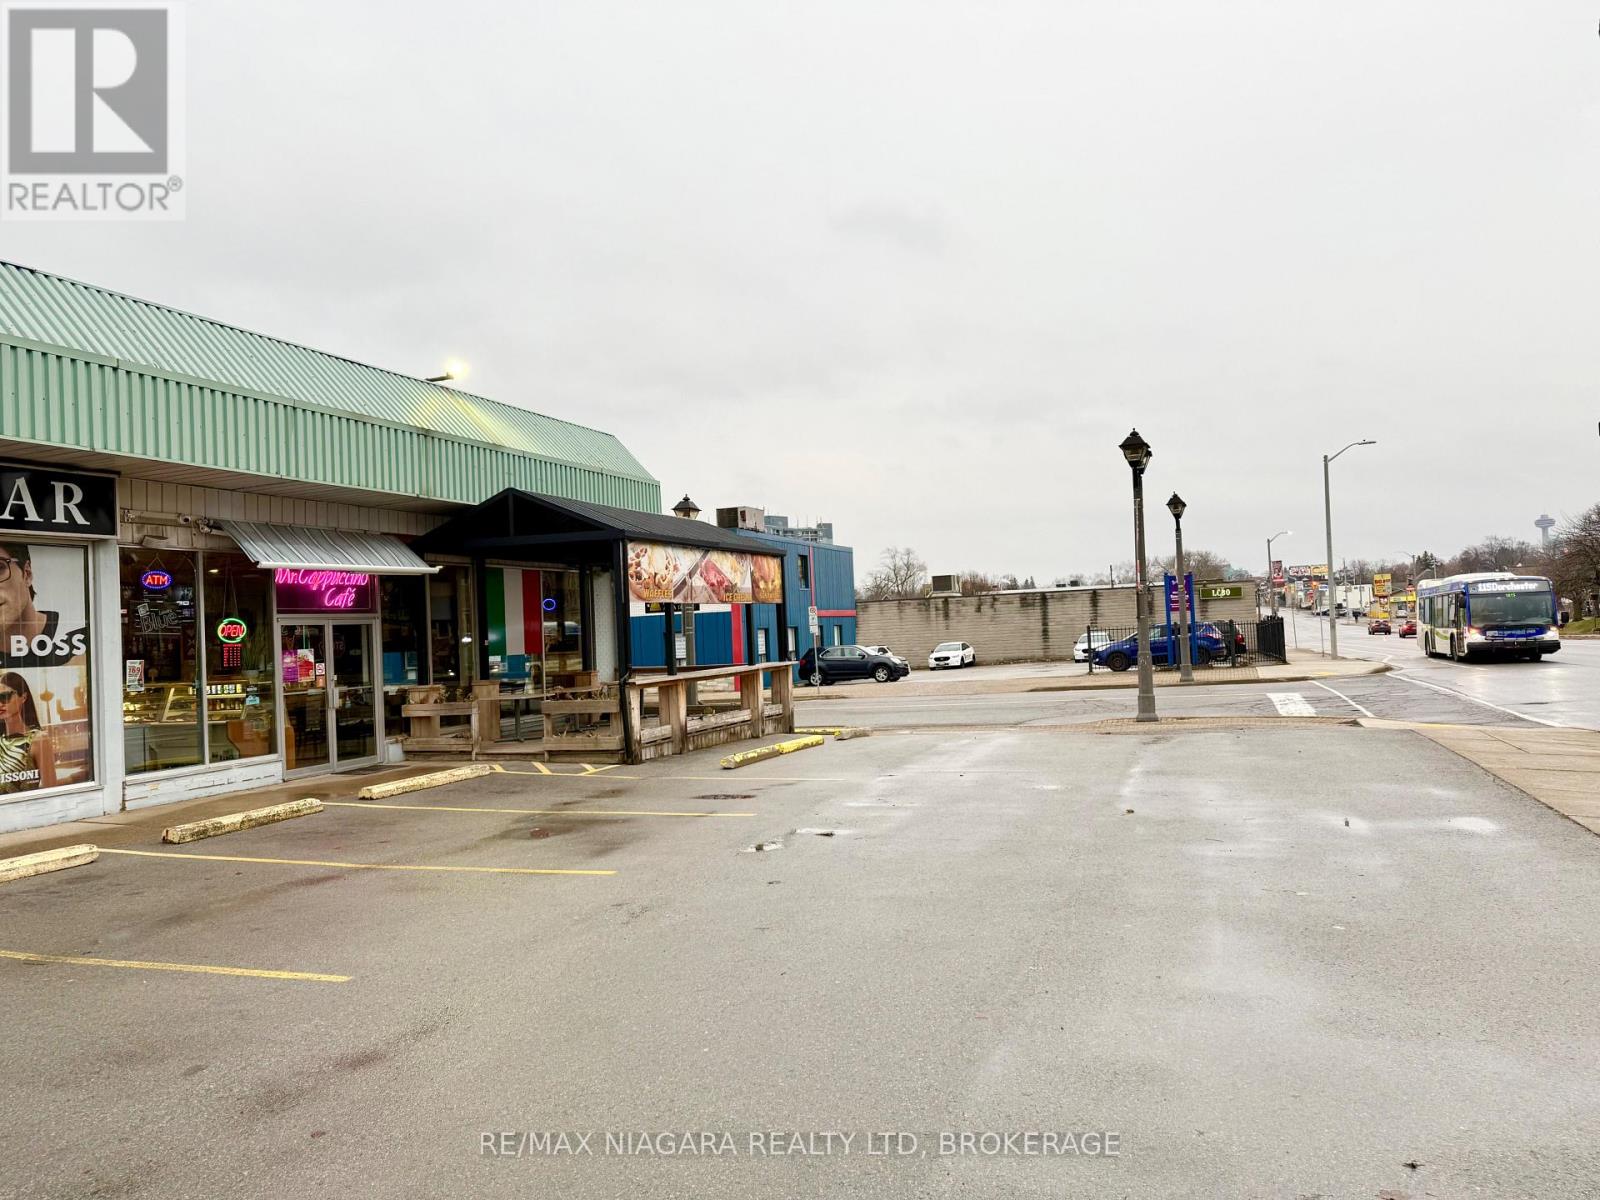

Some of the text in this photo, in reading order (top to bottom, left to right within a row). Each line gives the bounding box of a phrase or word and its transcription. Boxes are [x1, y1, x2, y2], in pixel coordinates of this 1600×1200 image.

[146, 575, 168, 585] ATM
[325, 587, 357, 608] Café
[1212, 589, 1231, 597] LCBO
[140, 611, 179, 633] Blue
[220, 624, 244, 636] OPEN
[10, 633, 87, 657] BOSS
